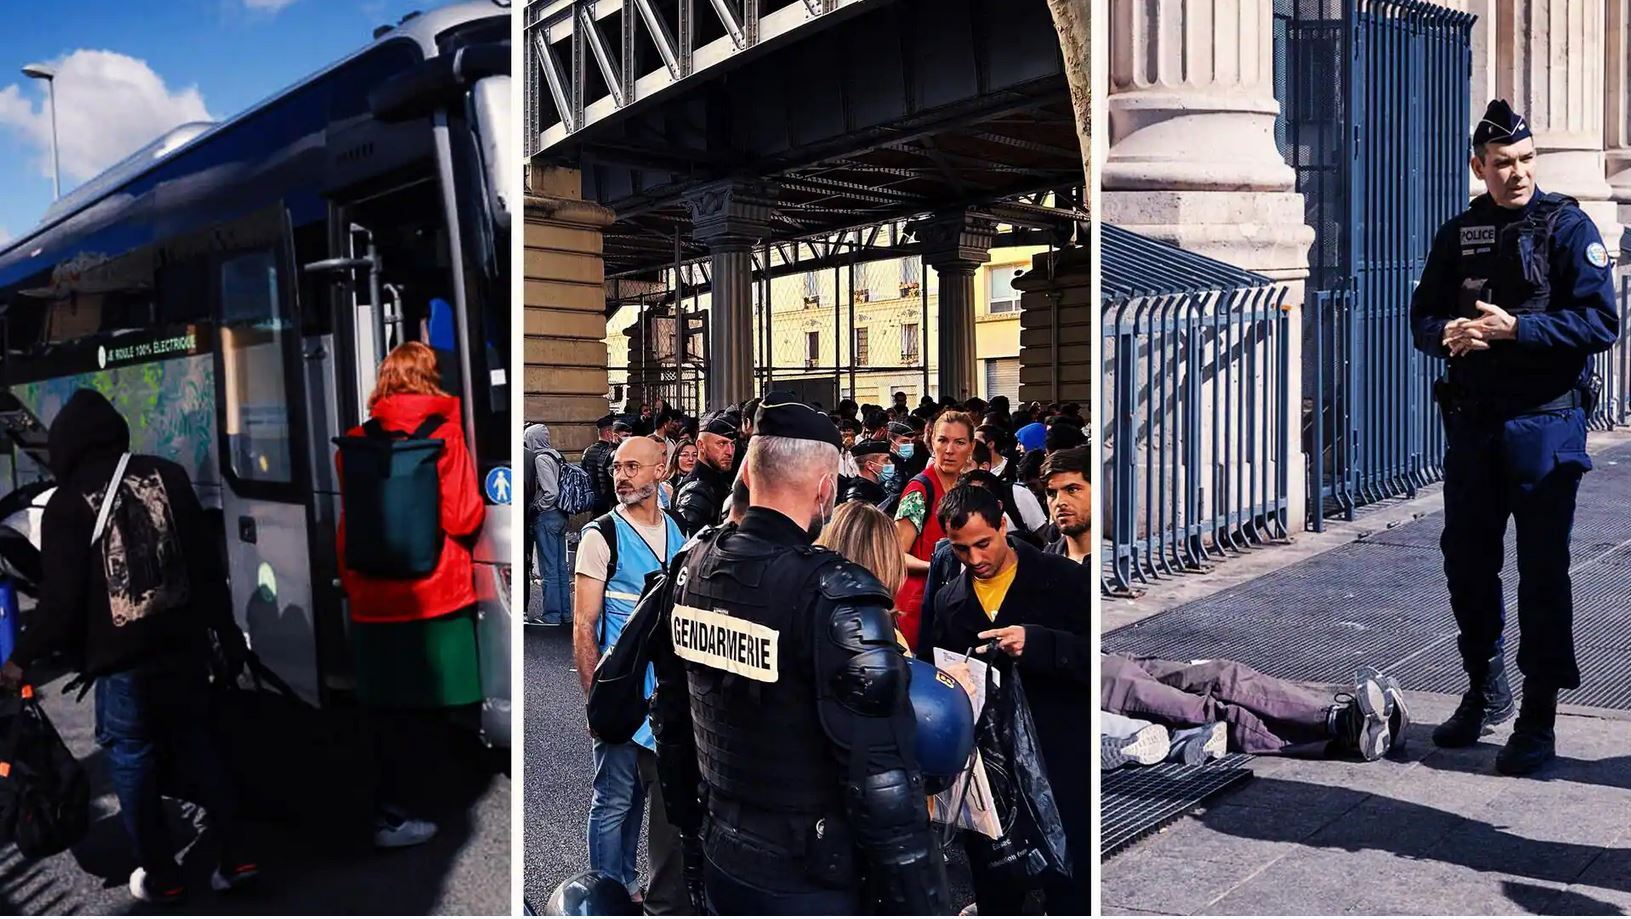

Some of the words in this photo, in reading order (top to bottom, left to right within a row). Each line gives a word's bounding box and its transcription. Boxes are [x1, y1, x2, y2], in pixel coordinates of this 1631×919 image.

[1461, 229, 1494, 241] POLICE
[115, 345, 134, 359] ROULE
[135, 343, 152, 356] 100%
[153, 334, 197, 354] ÉLECTRIQUE
[673, 616, 771, 670] GENDARMERIE
